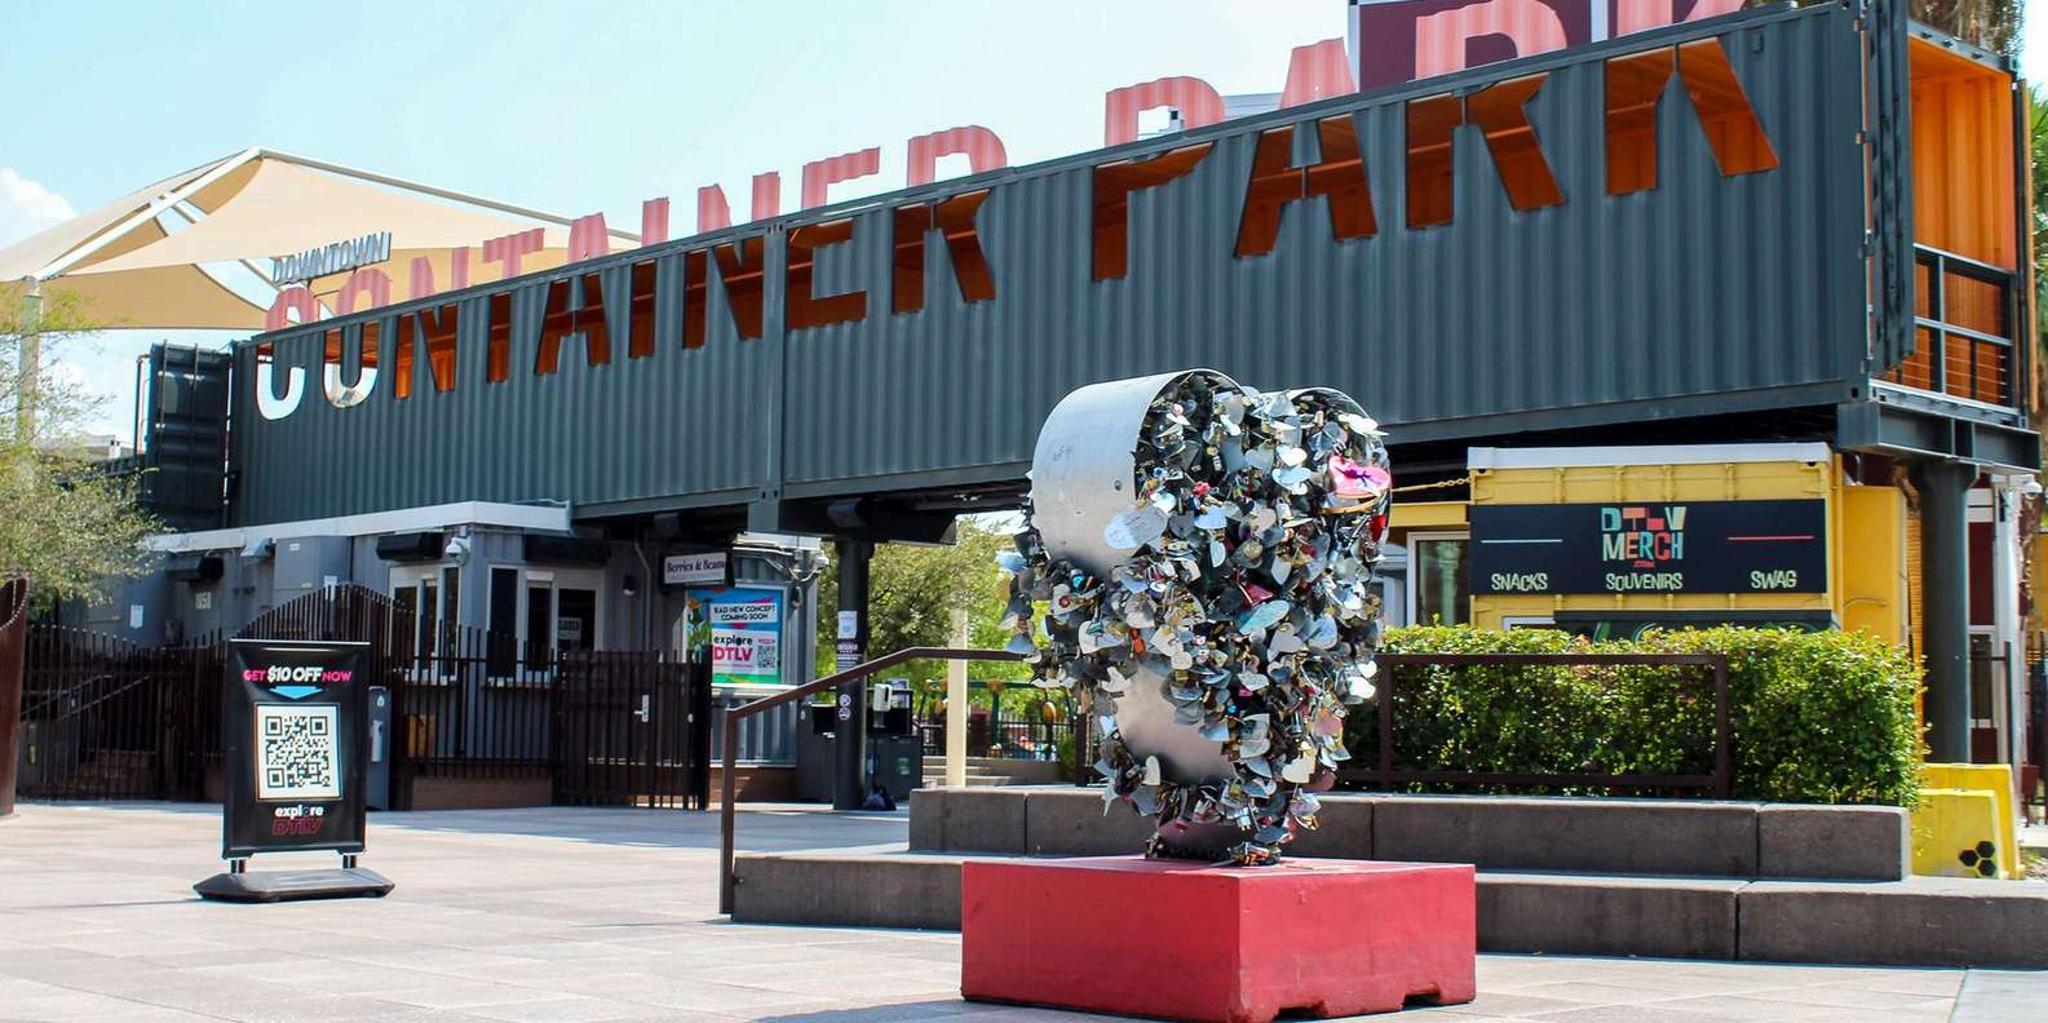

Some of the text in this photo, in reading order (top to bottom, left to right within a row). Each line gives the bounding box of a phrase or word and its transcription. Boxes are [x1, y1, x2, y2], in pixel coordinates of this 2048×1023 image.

[1092, 0, 1780, 280] PARK
[273, 232, 391, 285] DOWNTOWN
[1601, 506, 1687, 531] DTLV
[1602, 531, 1684, 561] MERCH
[666, 560, 694, 573] Berries
[695, 560, 702, 571] &
[1491, 572, 1548, 591] SNACKS
[1605, 572, 1683, 591] SOUVENIRS
[1750, 570, 1797, 589] SWAG
[721, 613, 748, 621] COMING
[745, 605, 775, 613] CONCEPT
[713, 635, 753, 648] explore
[713, 647, 753, 662] DTLV
[242, 665, 353, 683] GET $10 OFF NOW
[274, 804, 324, 820] explore
